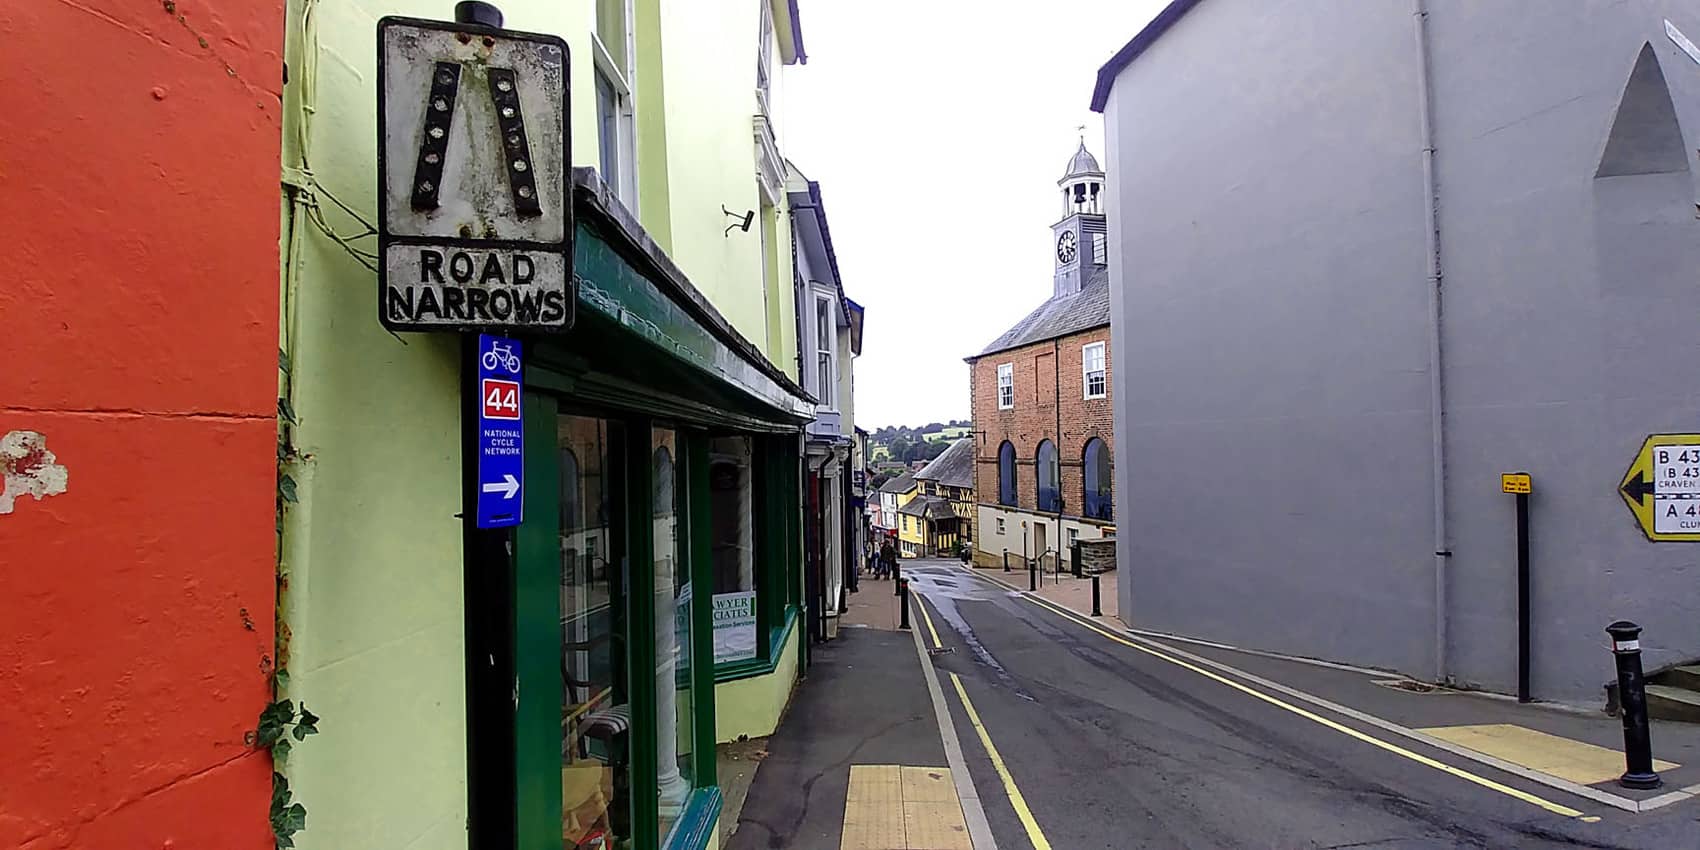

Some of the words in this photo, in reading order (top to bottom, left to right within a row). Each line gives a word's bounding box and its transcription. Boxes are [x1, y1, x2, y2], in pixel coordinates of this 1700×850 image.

[420, 250, 535, 284] ROAD
[388, 286, 565, 322] NARROWS
[486, 387, 518, 412] 44
[484, 430, 520, 438] NATIONAL
[491, 439, 514, 447] CYCLE
[484, 447, 520, 456] NETWORK
[1659, 450, 1670, 464] B
[1678, 450, 1700, 464] 43
[1663, 467, 1676, 479] (B
[1682, 467, 1700, 478] 43
[1658, 480, 1696, 488] CRAVEN
[1666, 504, 1678, 518] A
[712, 597, 748, 609] WYER
